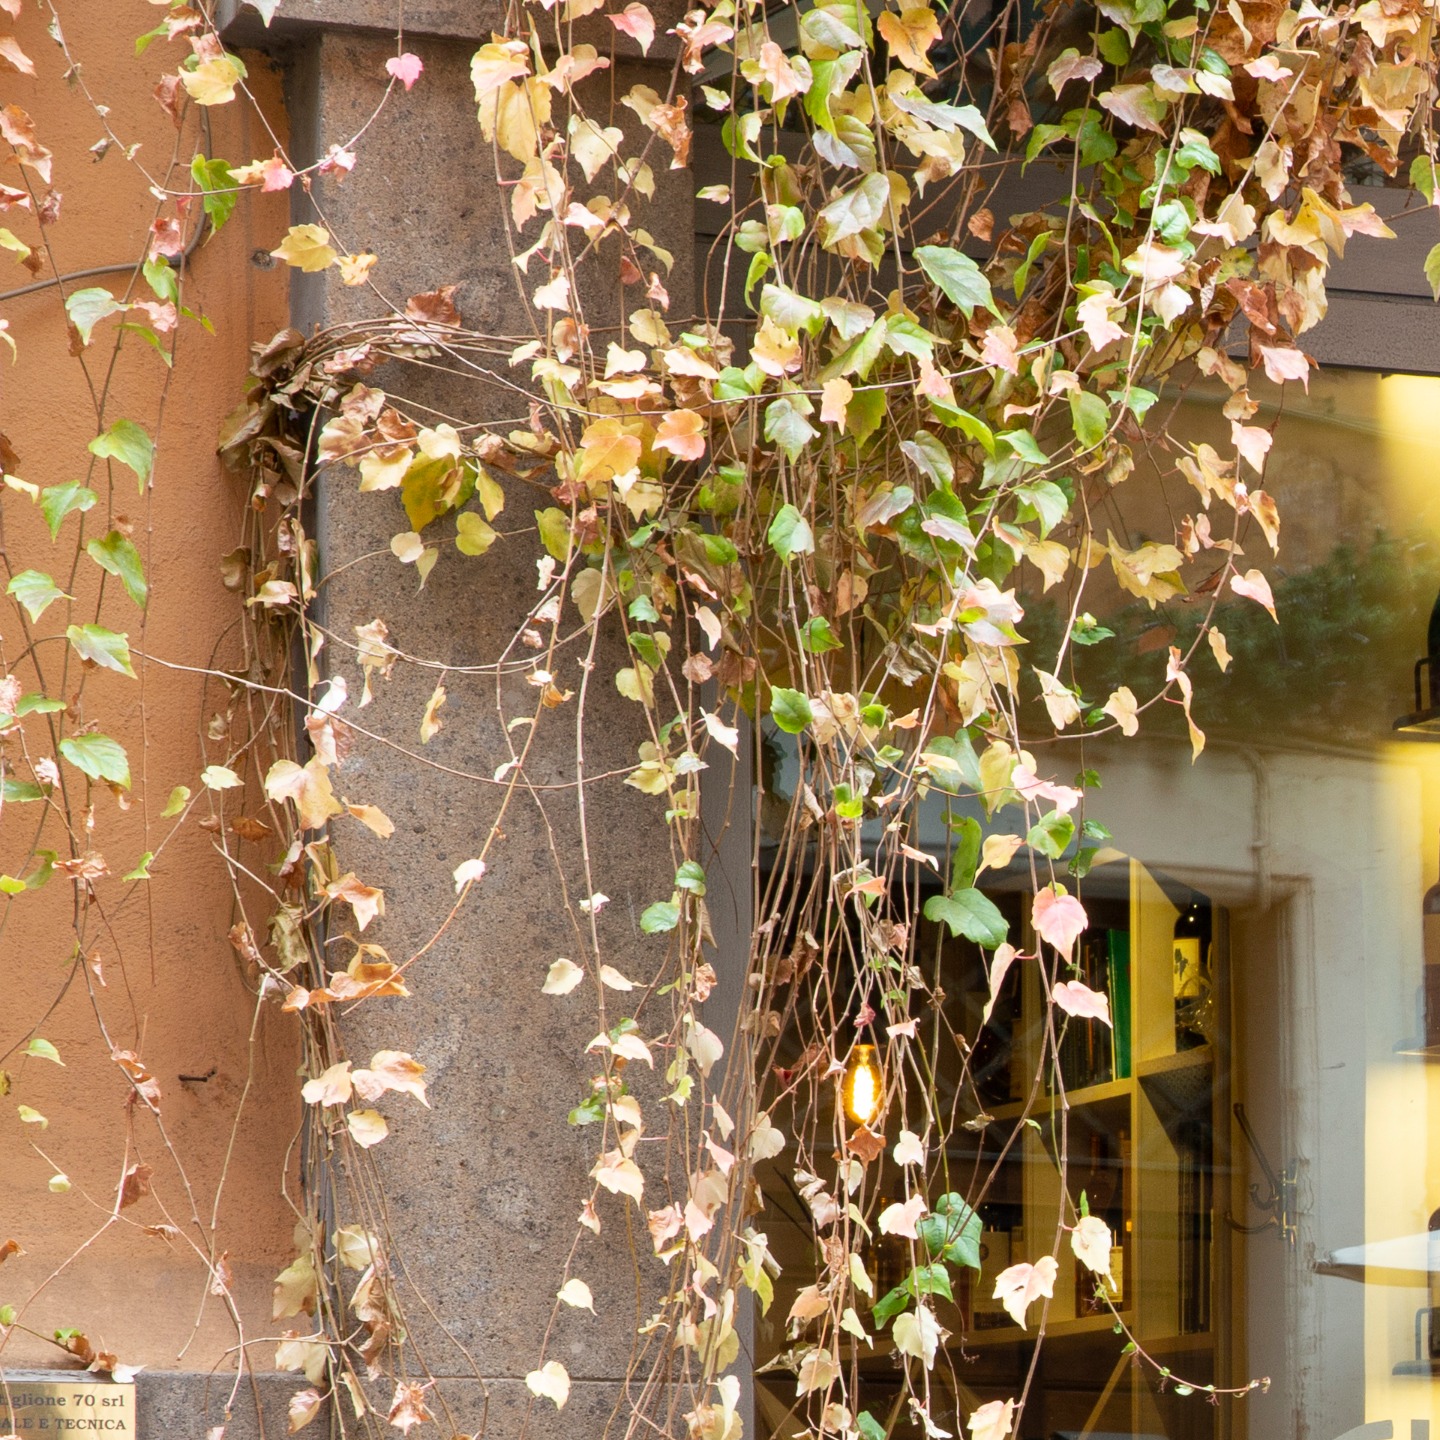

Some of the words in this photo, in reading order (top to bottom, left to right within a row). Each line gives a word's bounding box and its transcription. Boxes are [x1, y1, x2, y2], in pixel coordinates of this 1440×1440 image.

[73, 1394, 96, 1407] 70
[102, 1394, 125, 1407] srl
[39, 1418, 49, 1430] E
[55, 1418, 126, 1431] TECNICA
